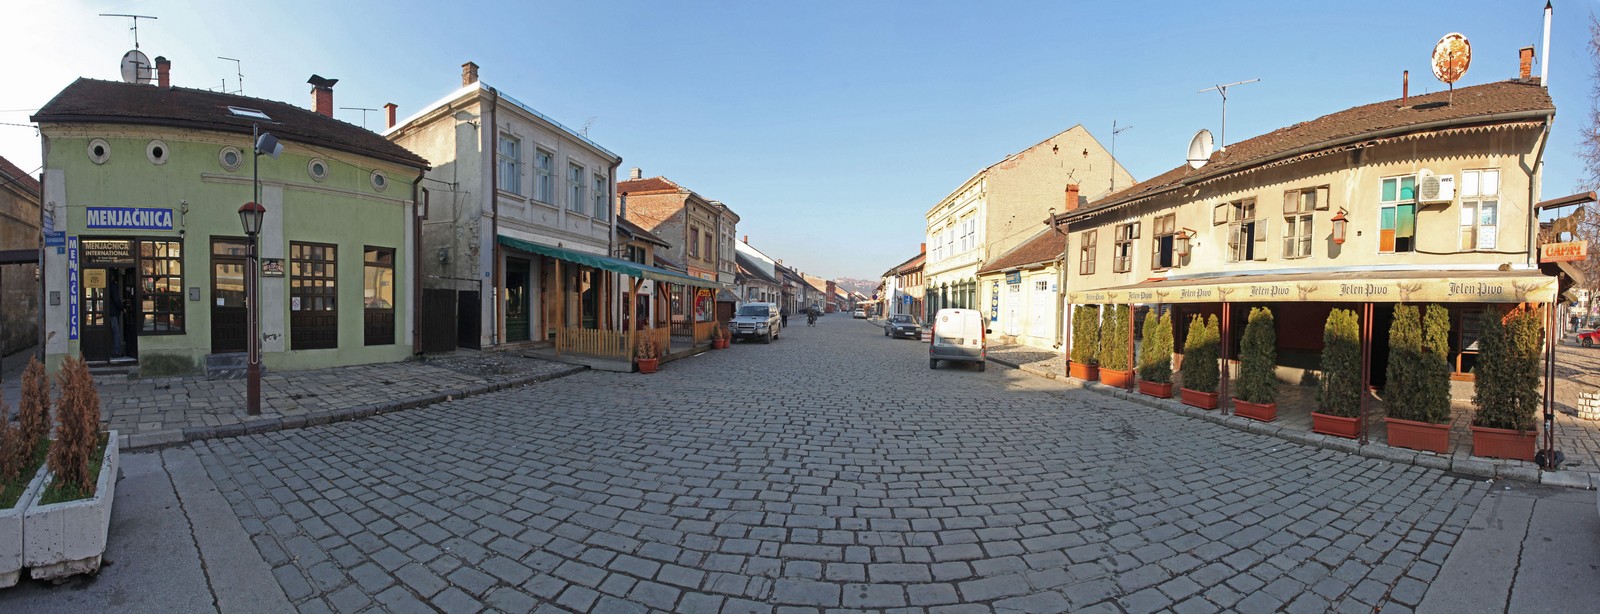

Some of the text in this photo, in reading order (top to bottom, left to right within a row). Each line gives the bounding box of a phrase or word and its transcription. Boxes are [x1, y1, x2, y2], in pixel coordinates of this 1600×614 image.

[87, 208, 172, 227] MENJAČNICA
[68, 240, 77, 336] MENJAČNICA
[1180, 288, 1212, 298] Jelen Pivo
[1250, 286, 1289, 297] Jelen Pivo
[1339, 284, 1388, 296] Jelen Pivo
[1448, 282, 1502, 296] Jelen Pivo
